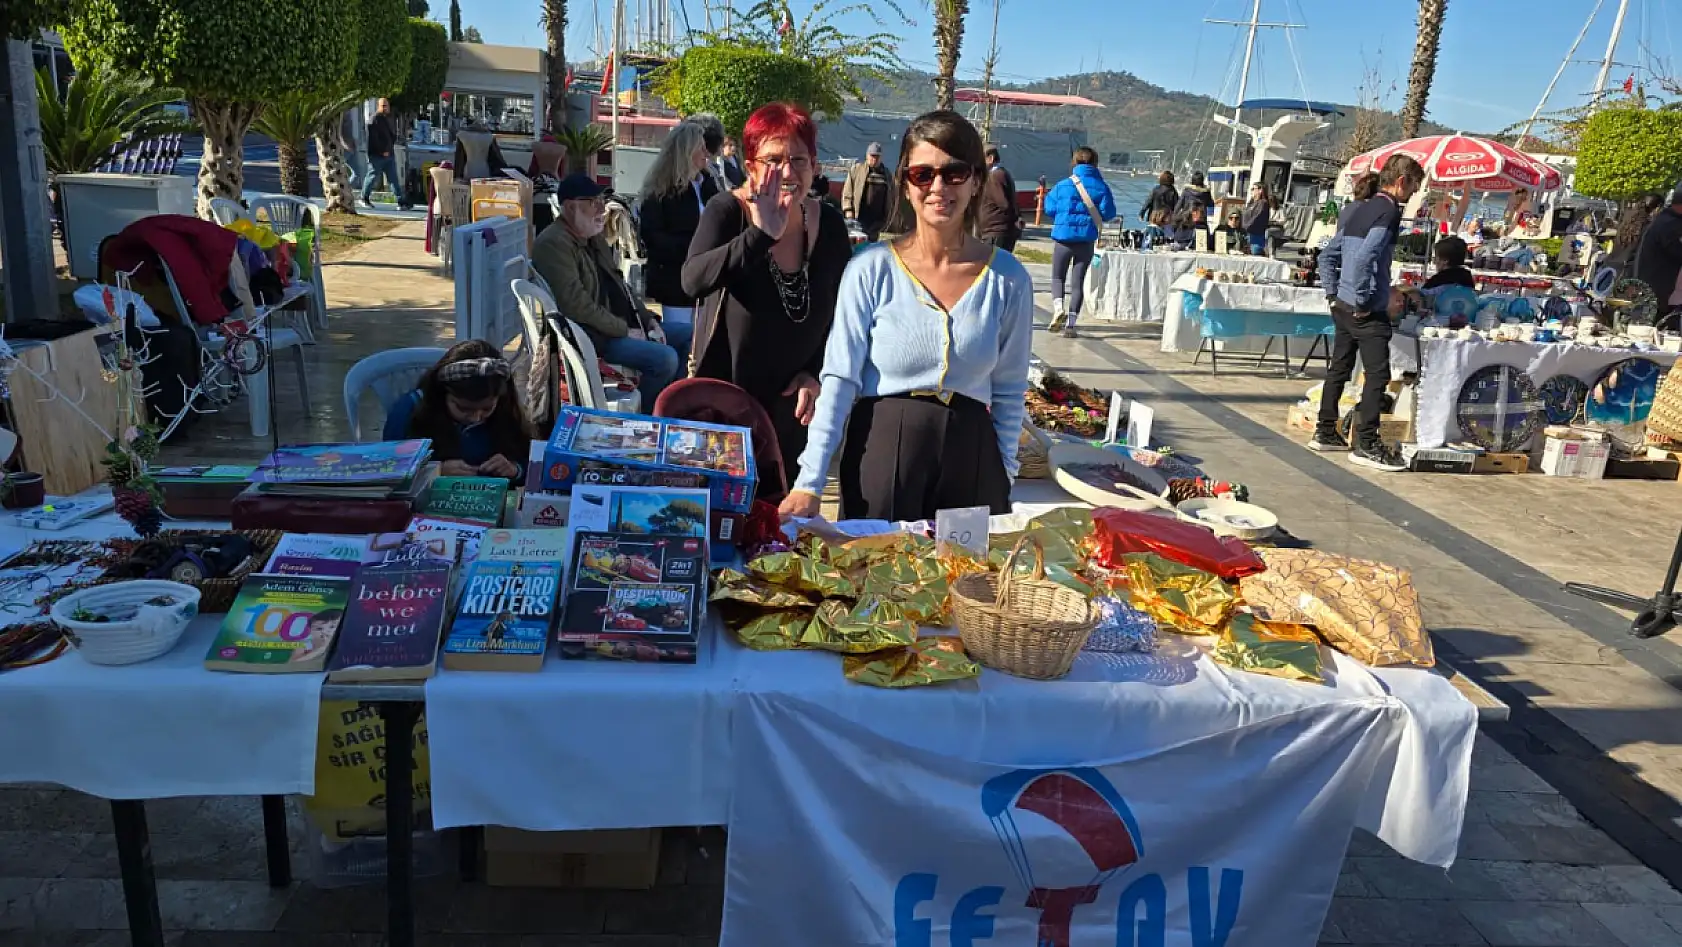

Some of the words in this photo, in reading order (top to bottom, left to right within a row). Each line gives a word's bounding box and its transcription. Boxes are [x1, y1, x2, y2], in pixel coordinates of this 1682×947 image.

[1445, 164, 1486, 175] ALGIDA
[429, 500, 497, 513] ATKINSON
[950, 530, 972, 545] 50
[489, 546, 516, 557] Last
[519, 546, 558, 557] Letter
[260, 583, 297, 592] Adem
[357, 583, 444, 601] before
[469, 575, 554, 596] POSTCARD
[380, 606, 415, 618] we
[462, 594, 551, 616] KILLERS
[244, 604, 313, 642] 100
[367, 621, 418, 637] met
[894, 866, 1244, 947] FETAV
